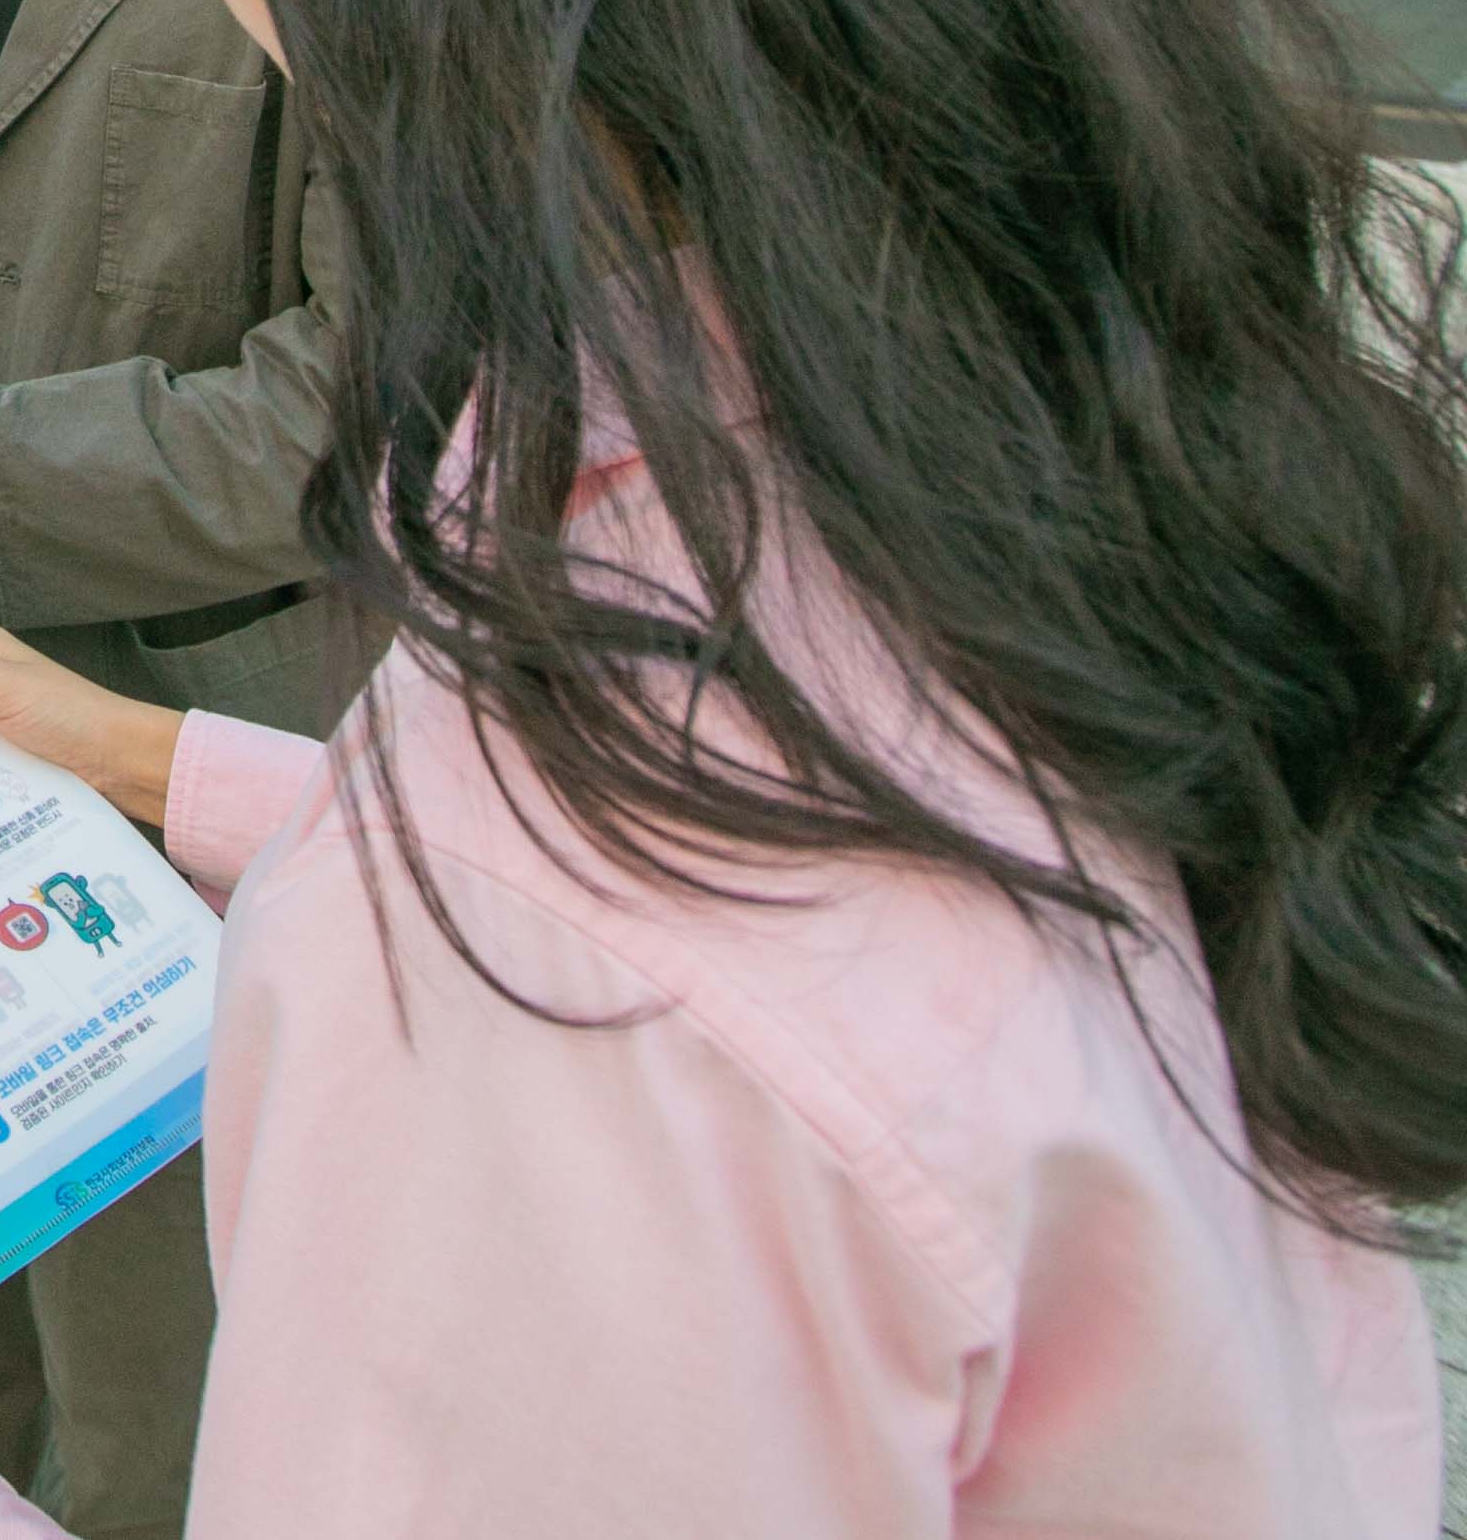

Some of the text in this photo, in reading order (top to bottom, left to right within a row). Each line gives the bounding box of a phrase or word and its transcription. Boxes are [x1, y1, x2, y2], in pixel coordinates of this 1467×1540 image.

[34, 1043, 66, 1071] 링크
[62, 1017, 105, 1051] 접속은
[102, 990, 145, 1022] 무조건
[142, 956, 196, 997] 의심하기
[10, 1028, 136, 1118] 모바일을 통한 링크 접속은 명확한
[19, 1053, 127, 1131] 검증된 사이트인지 확인하기
